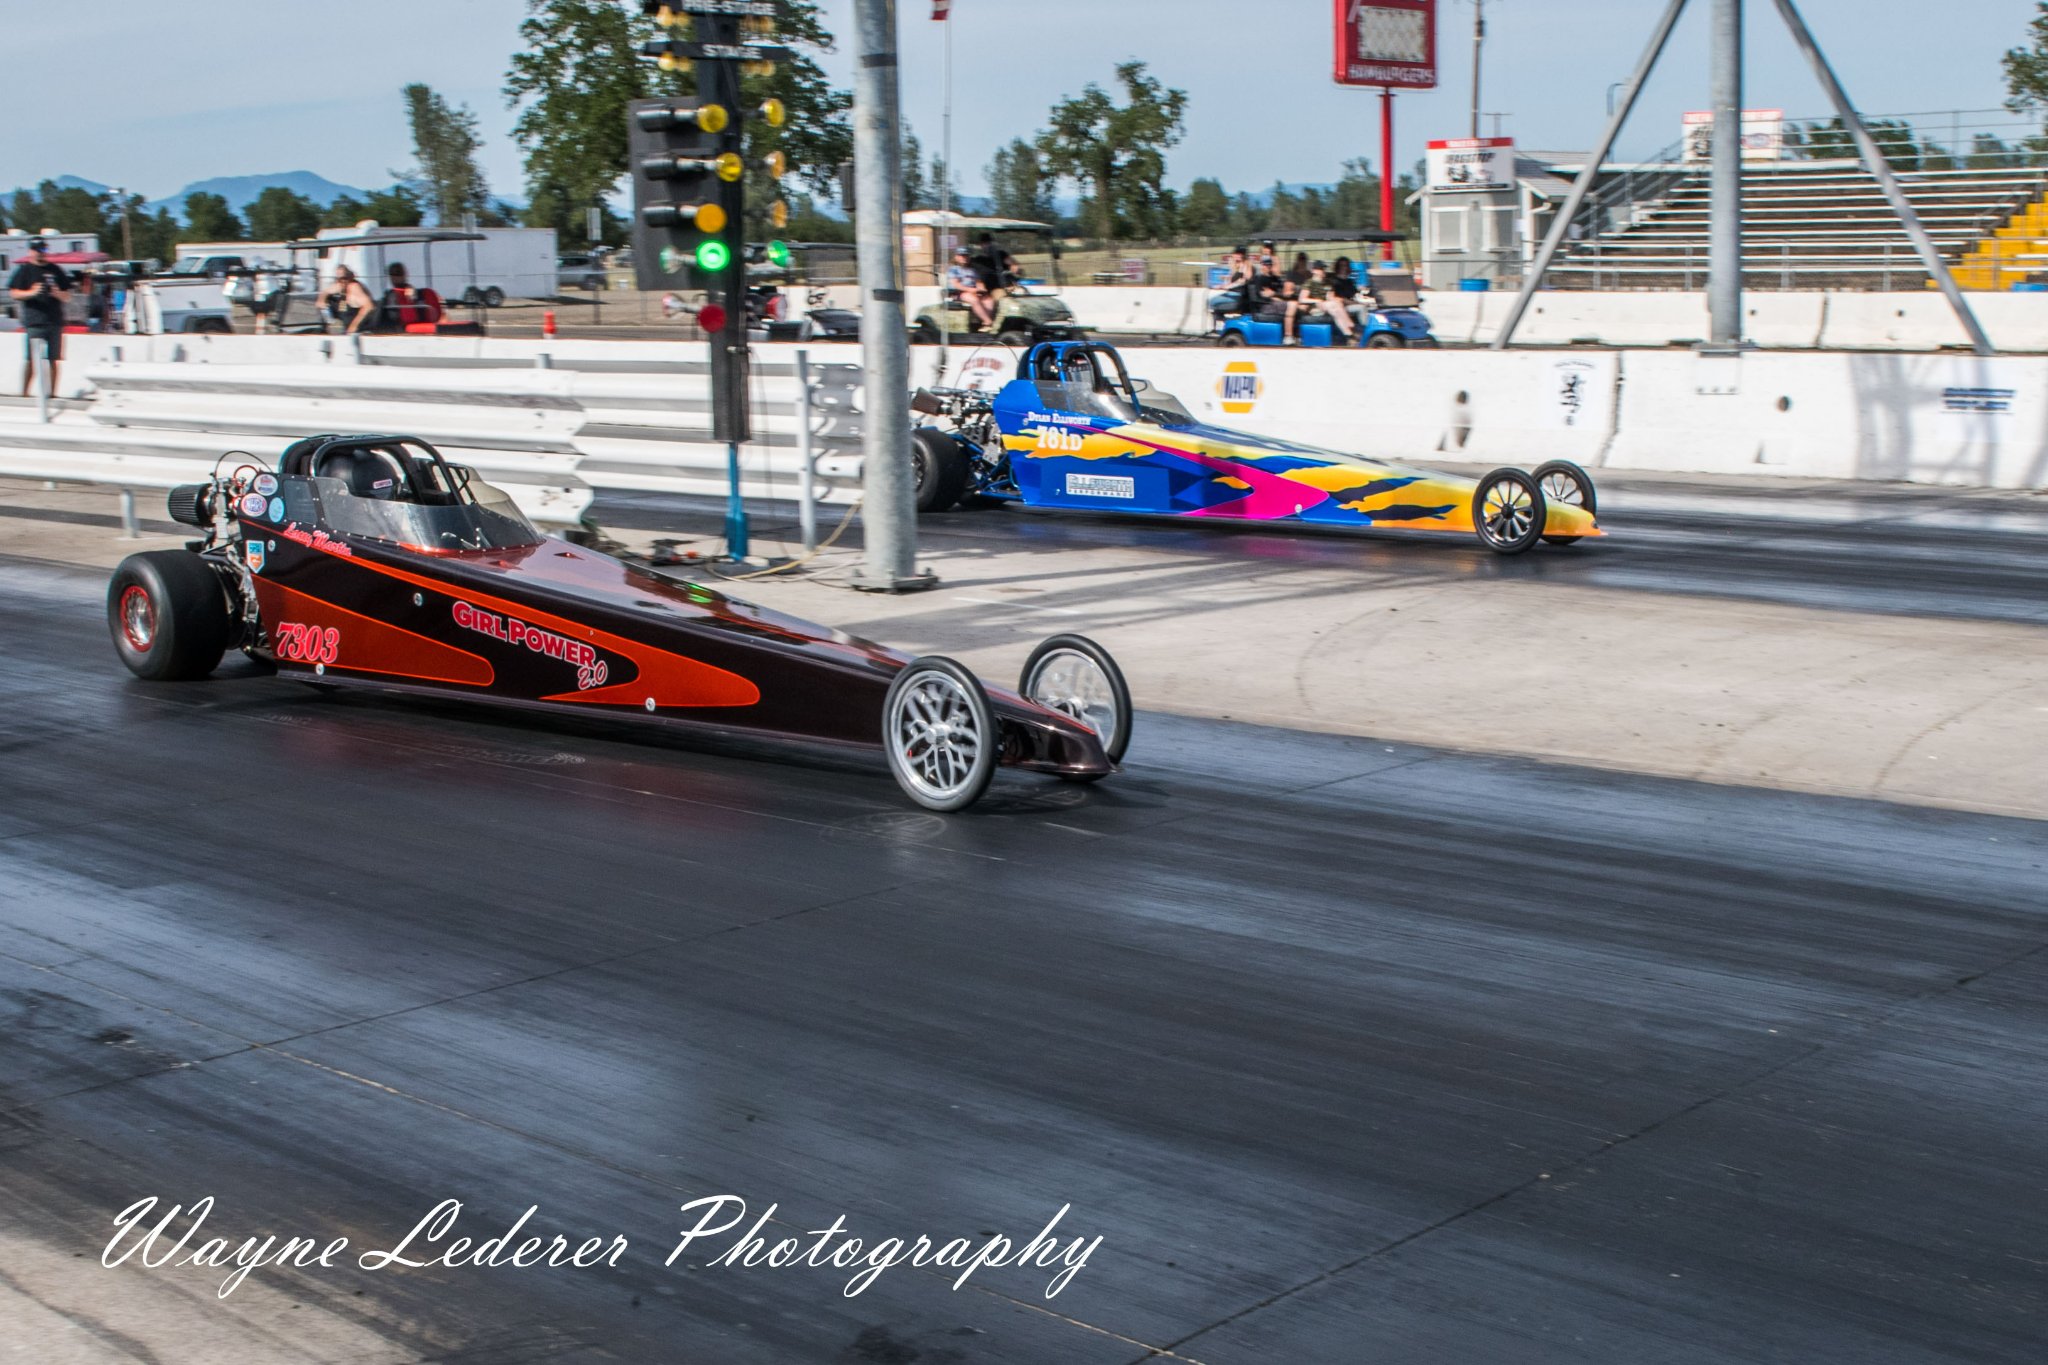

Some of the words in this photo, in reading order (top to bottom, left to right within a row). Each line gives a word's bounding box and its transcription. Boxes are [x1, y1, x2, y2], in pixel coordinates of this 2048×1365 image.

[703, 44, 763, 60] STAGE
[1223, 375, 1258, 399] NAPA
[1037, 425, 1082, 451] 781D
[276, 622, 340, 664] 7303
[453, 601, 507, 642] GIRL
[508, 618, 596, 670] POWER
[578, 661, 608, 690] 2.0
